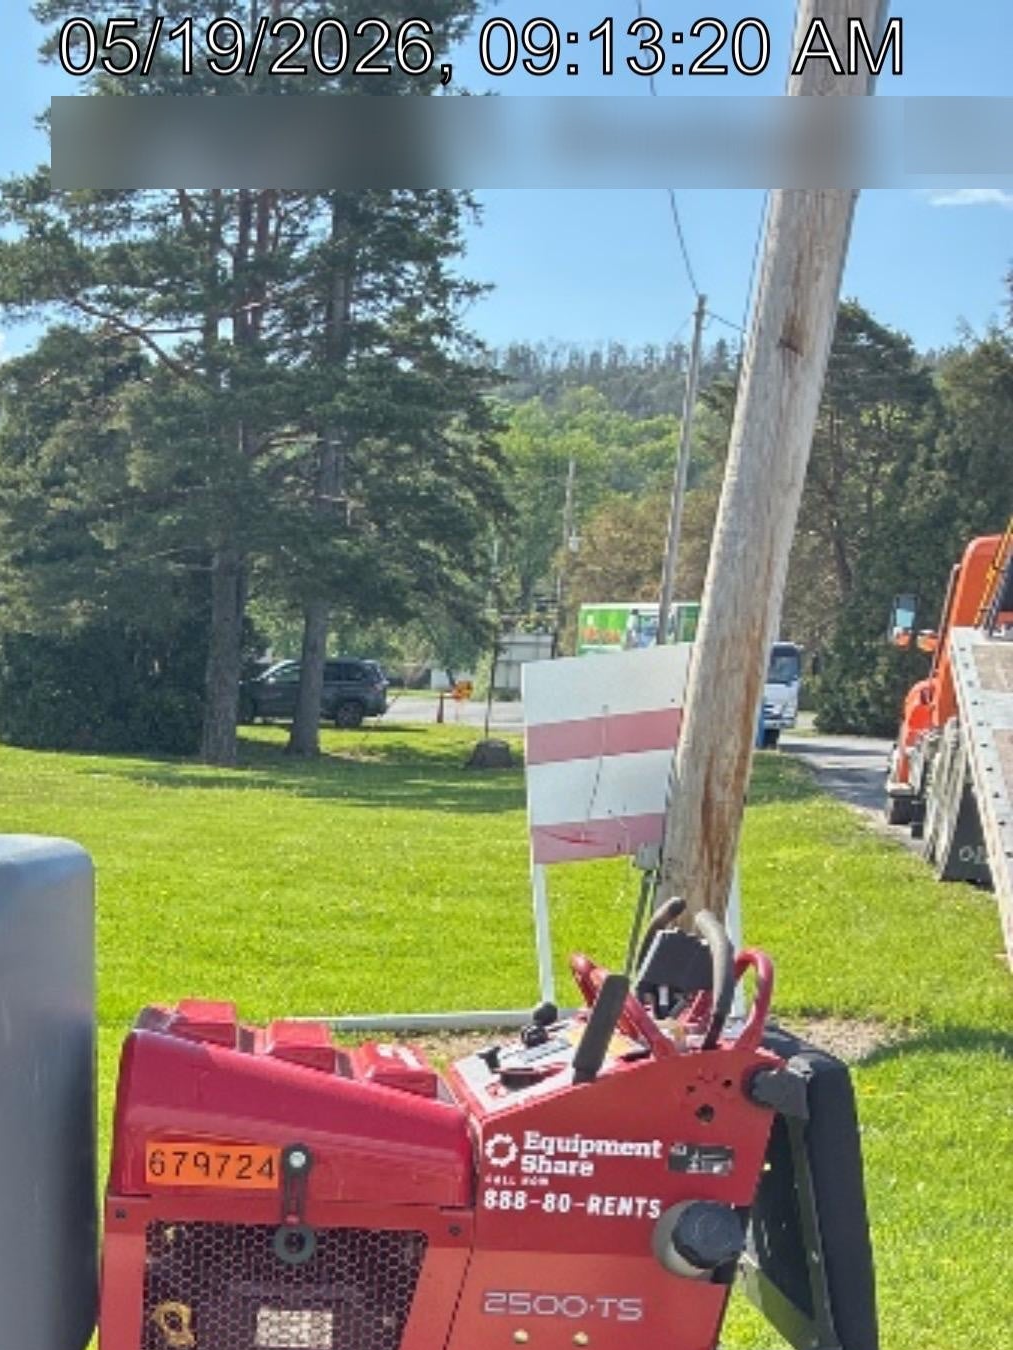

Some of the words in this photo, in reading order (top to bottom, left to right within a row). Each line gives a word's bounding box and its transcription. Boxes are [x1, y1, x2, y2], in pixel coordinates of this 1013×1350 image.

[523, 1130, 664, 1160] Equipment
[148, 1149, 276, 1181] 679724
[520, 1154, 595, 1177] Share
[483, 1188, 662, 1219] 888-80-RENTS
